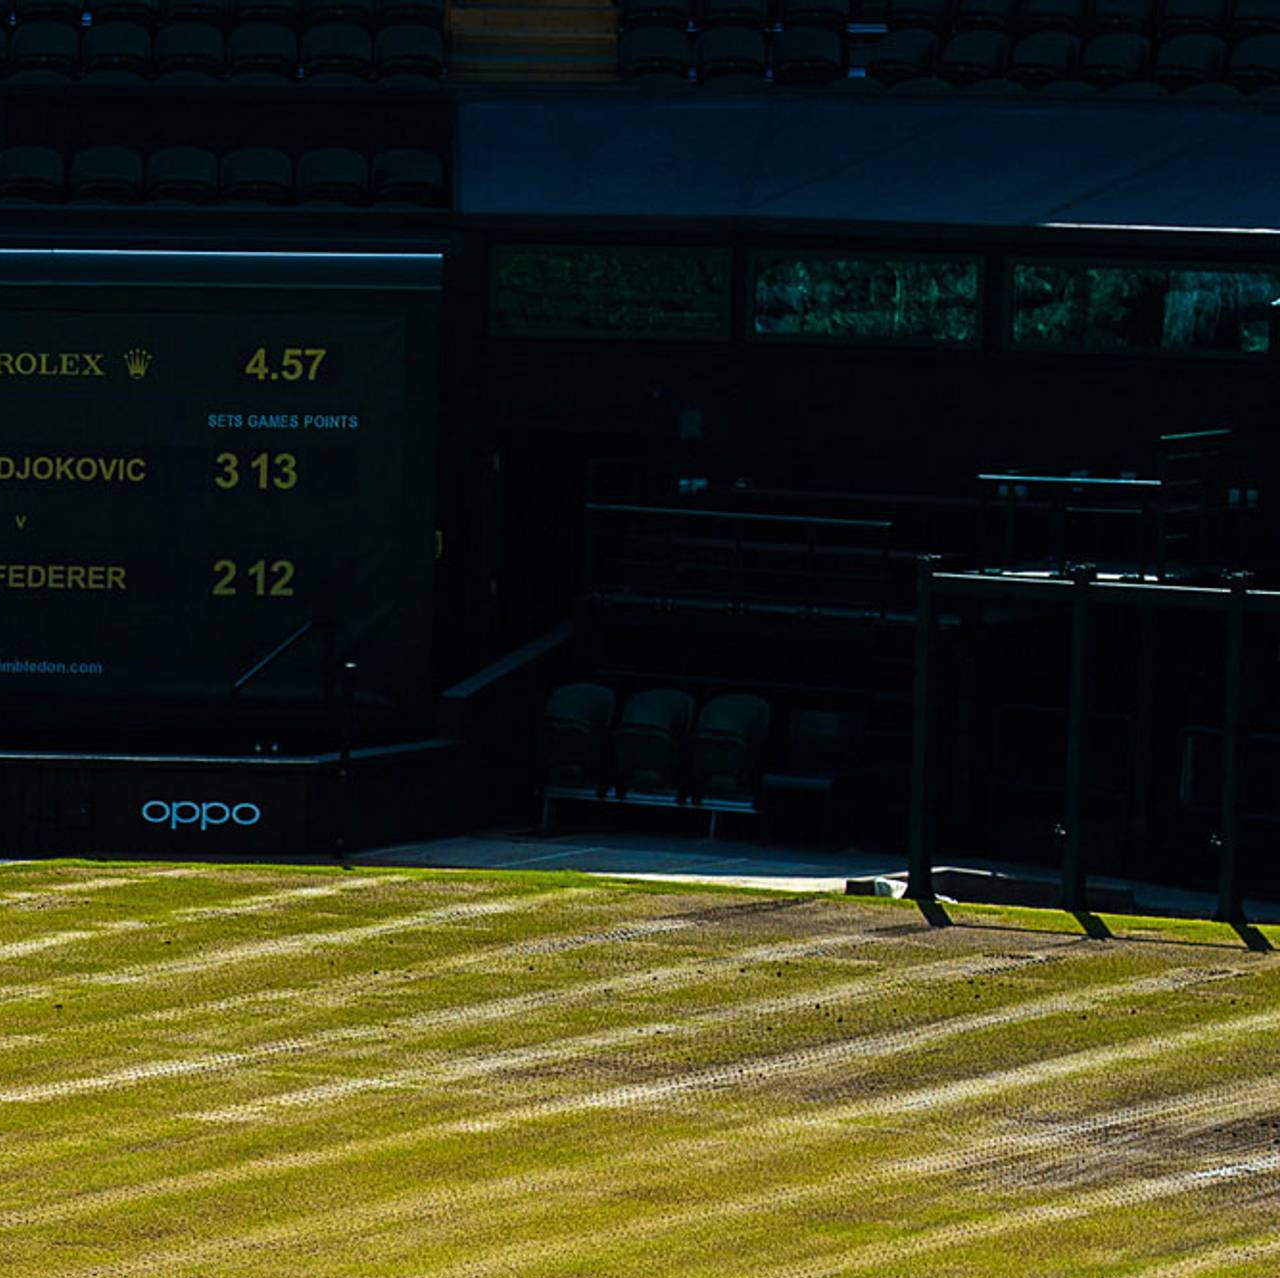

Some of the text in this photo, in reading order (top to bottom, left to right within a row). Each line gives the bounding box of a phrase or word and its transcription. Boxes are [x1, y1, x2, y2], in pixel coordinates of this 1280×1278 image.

[246, 348, 326, 380] 4.57
[209, 415, 358, 429] SETS GAMES POINTS
[142, 801, 260, 830] oppo
